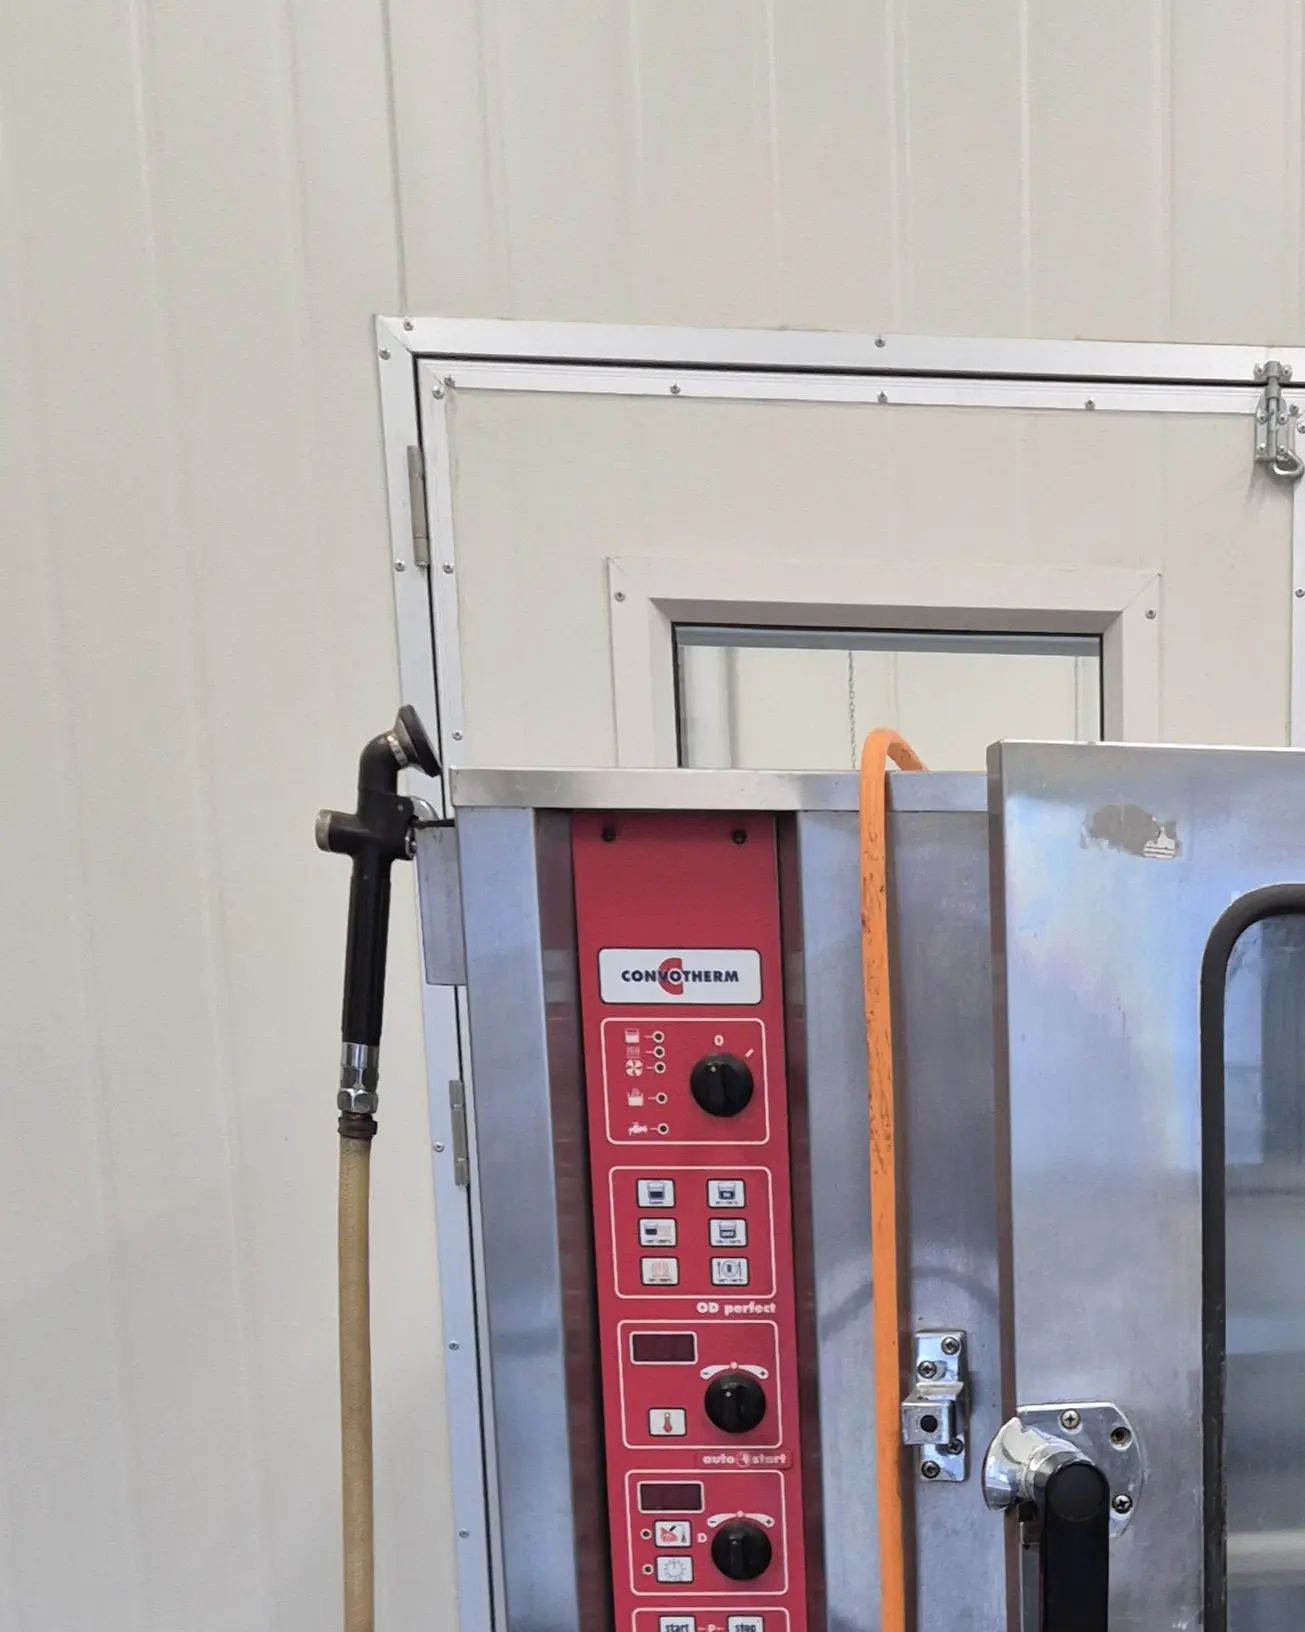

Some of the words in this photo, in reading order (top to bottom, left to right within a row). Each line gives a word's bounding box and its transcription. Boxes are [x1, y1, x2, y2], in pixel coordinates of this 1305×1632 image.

[620, 969, 740, 983] CONVOTHERM
[723, 1301, 777, 1316] perfect
[702, 1453, 736, 1465] auto
[751, 1453, 787, 1465] start
[665, 1623, 689, 1632] start
